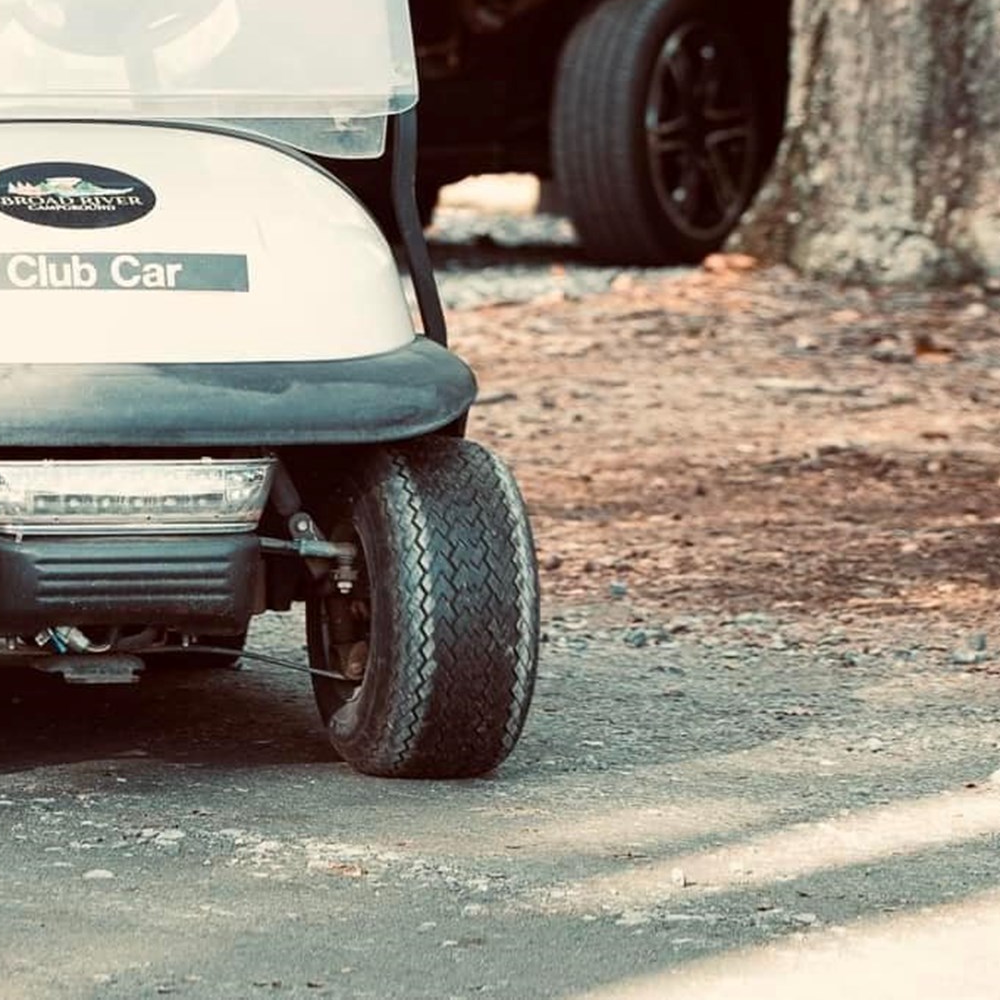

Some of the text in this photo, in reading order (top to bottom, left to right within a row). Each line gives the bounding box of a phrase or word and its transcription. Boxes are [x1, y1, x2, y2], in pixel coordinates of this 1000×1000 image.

[0, 196, 143, 206] BROAD RIVER
[6, 254, 182, 288] Club Car
